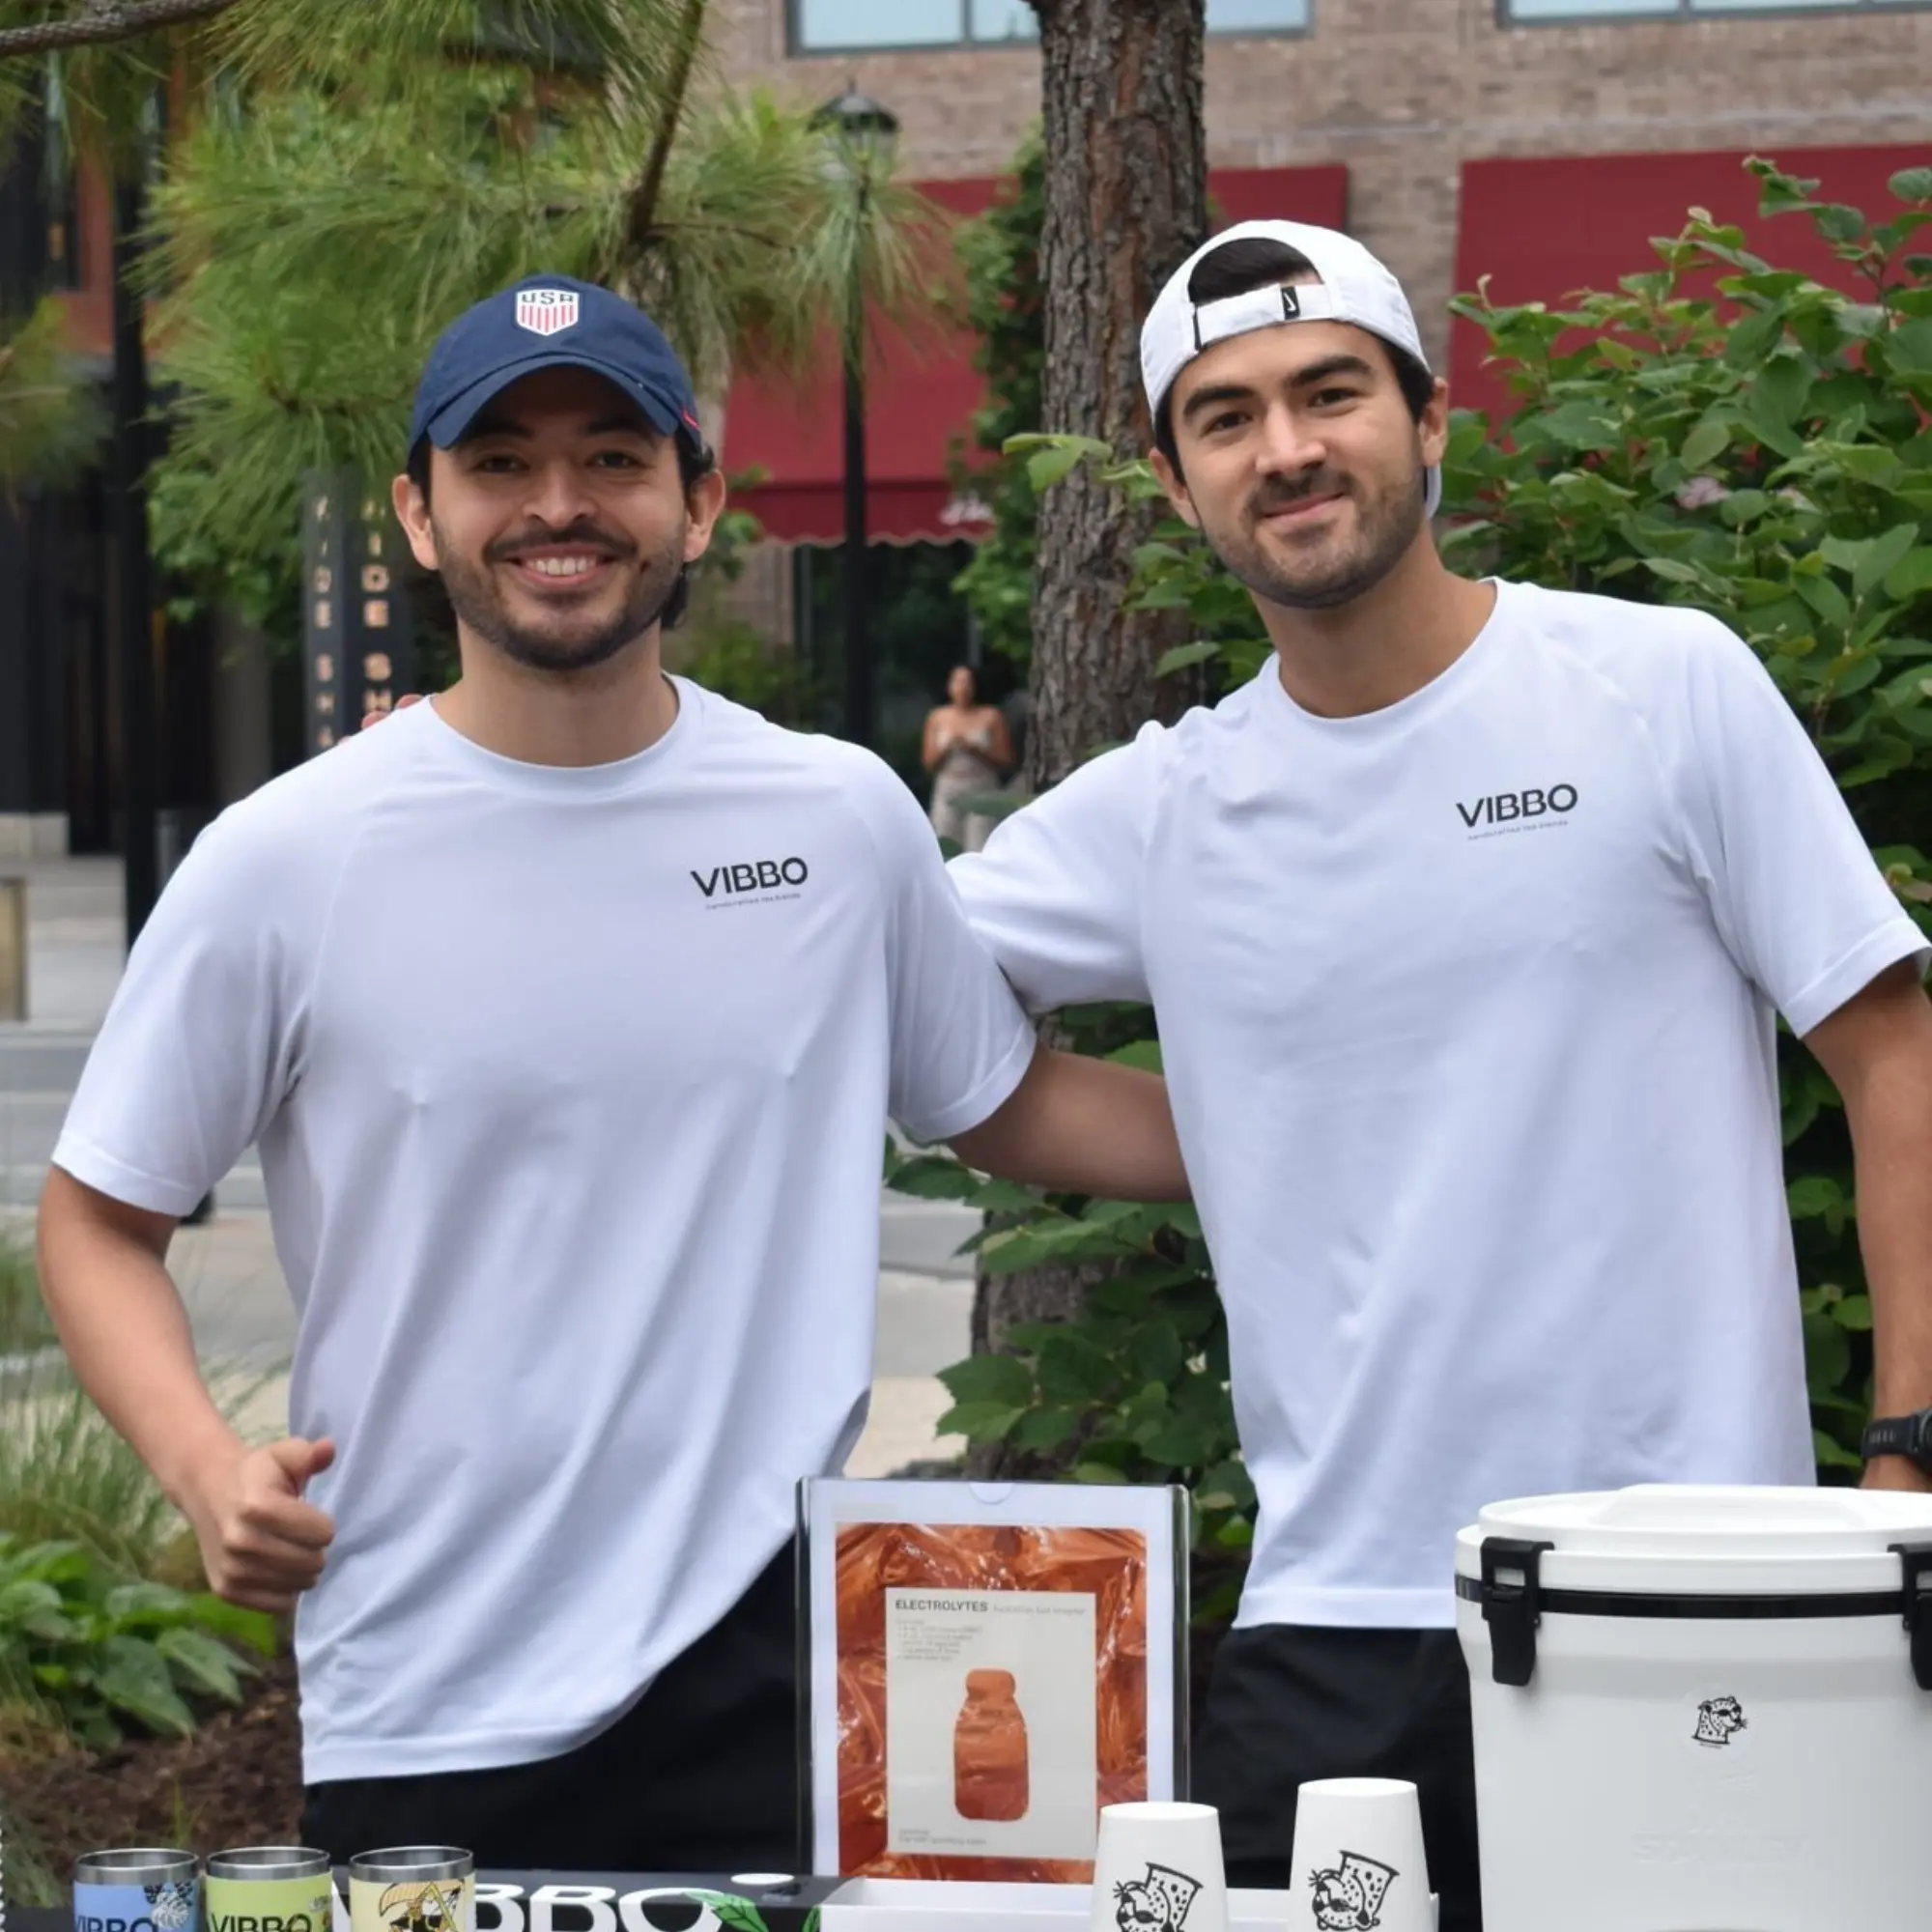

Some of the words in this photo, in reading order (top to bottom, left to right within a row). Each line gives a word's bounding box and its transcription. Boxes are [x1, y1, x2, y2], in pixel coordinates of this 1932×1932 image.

[522, 292, 574, 304] USA
[1456, 783, 1578, 828] VIBBO
[690, 857, 809, 897] VIBBO
[895, 1599, 989, 1612] ELECTROLYTES
